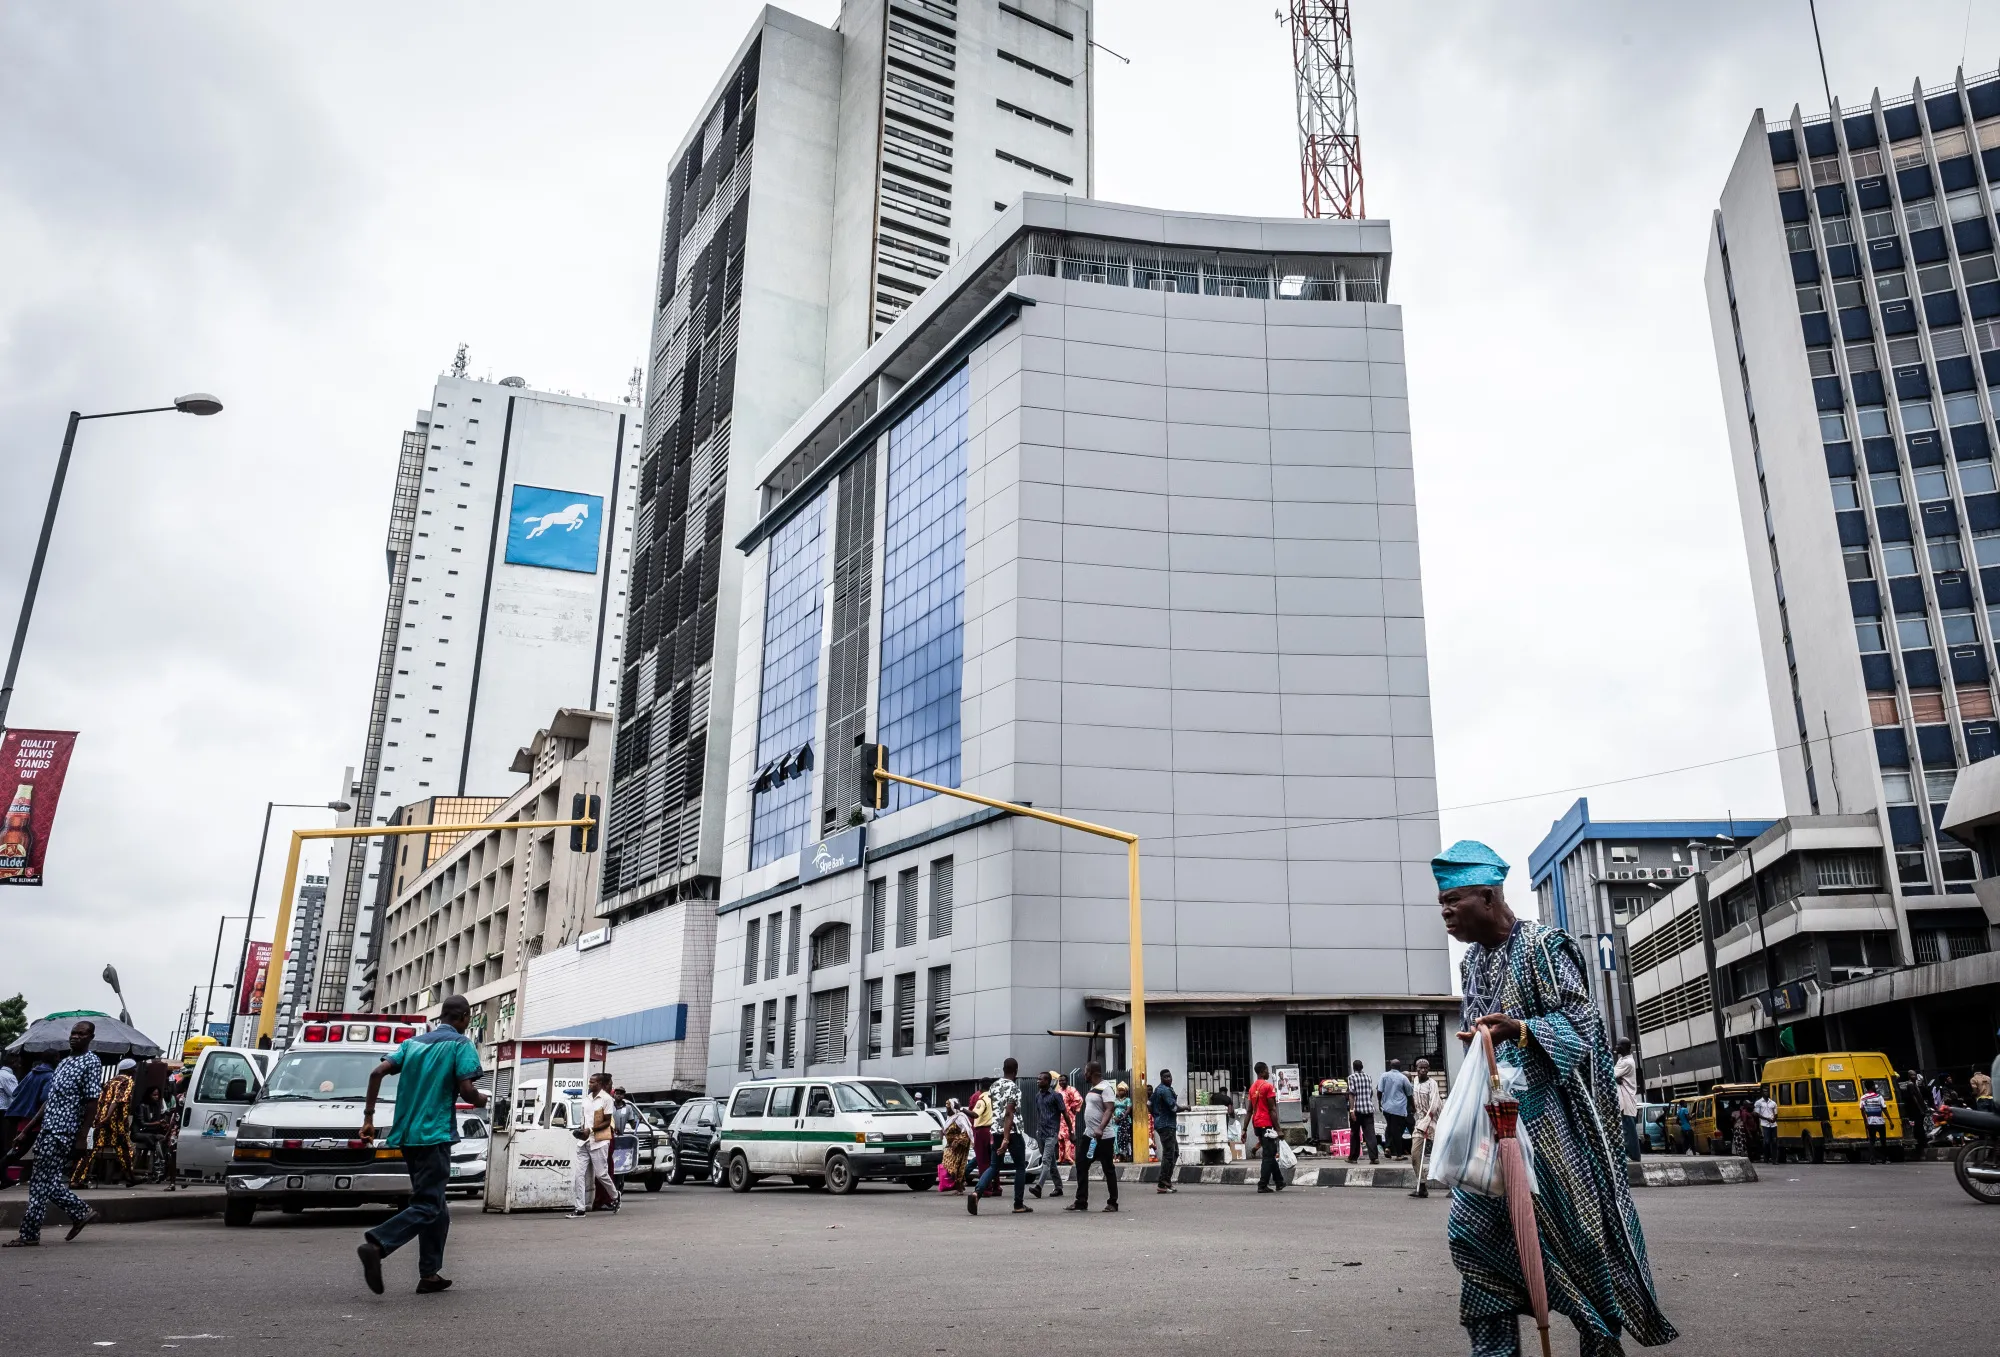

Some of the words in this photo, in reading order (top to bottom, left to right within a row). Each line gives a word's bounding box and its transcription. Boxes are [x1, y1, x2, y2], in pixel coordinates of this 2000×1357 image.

[21, 739, 57, 748] QUALITY
[17, 749, 54, 758] ALWAYS
[14, 759, 50, 769] STANDS
[20, 770, 38, 778] OUT
[0, 857, 25, 867] ulder
[541, 1043, 571, 1054] POLICE
